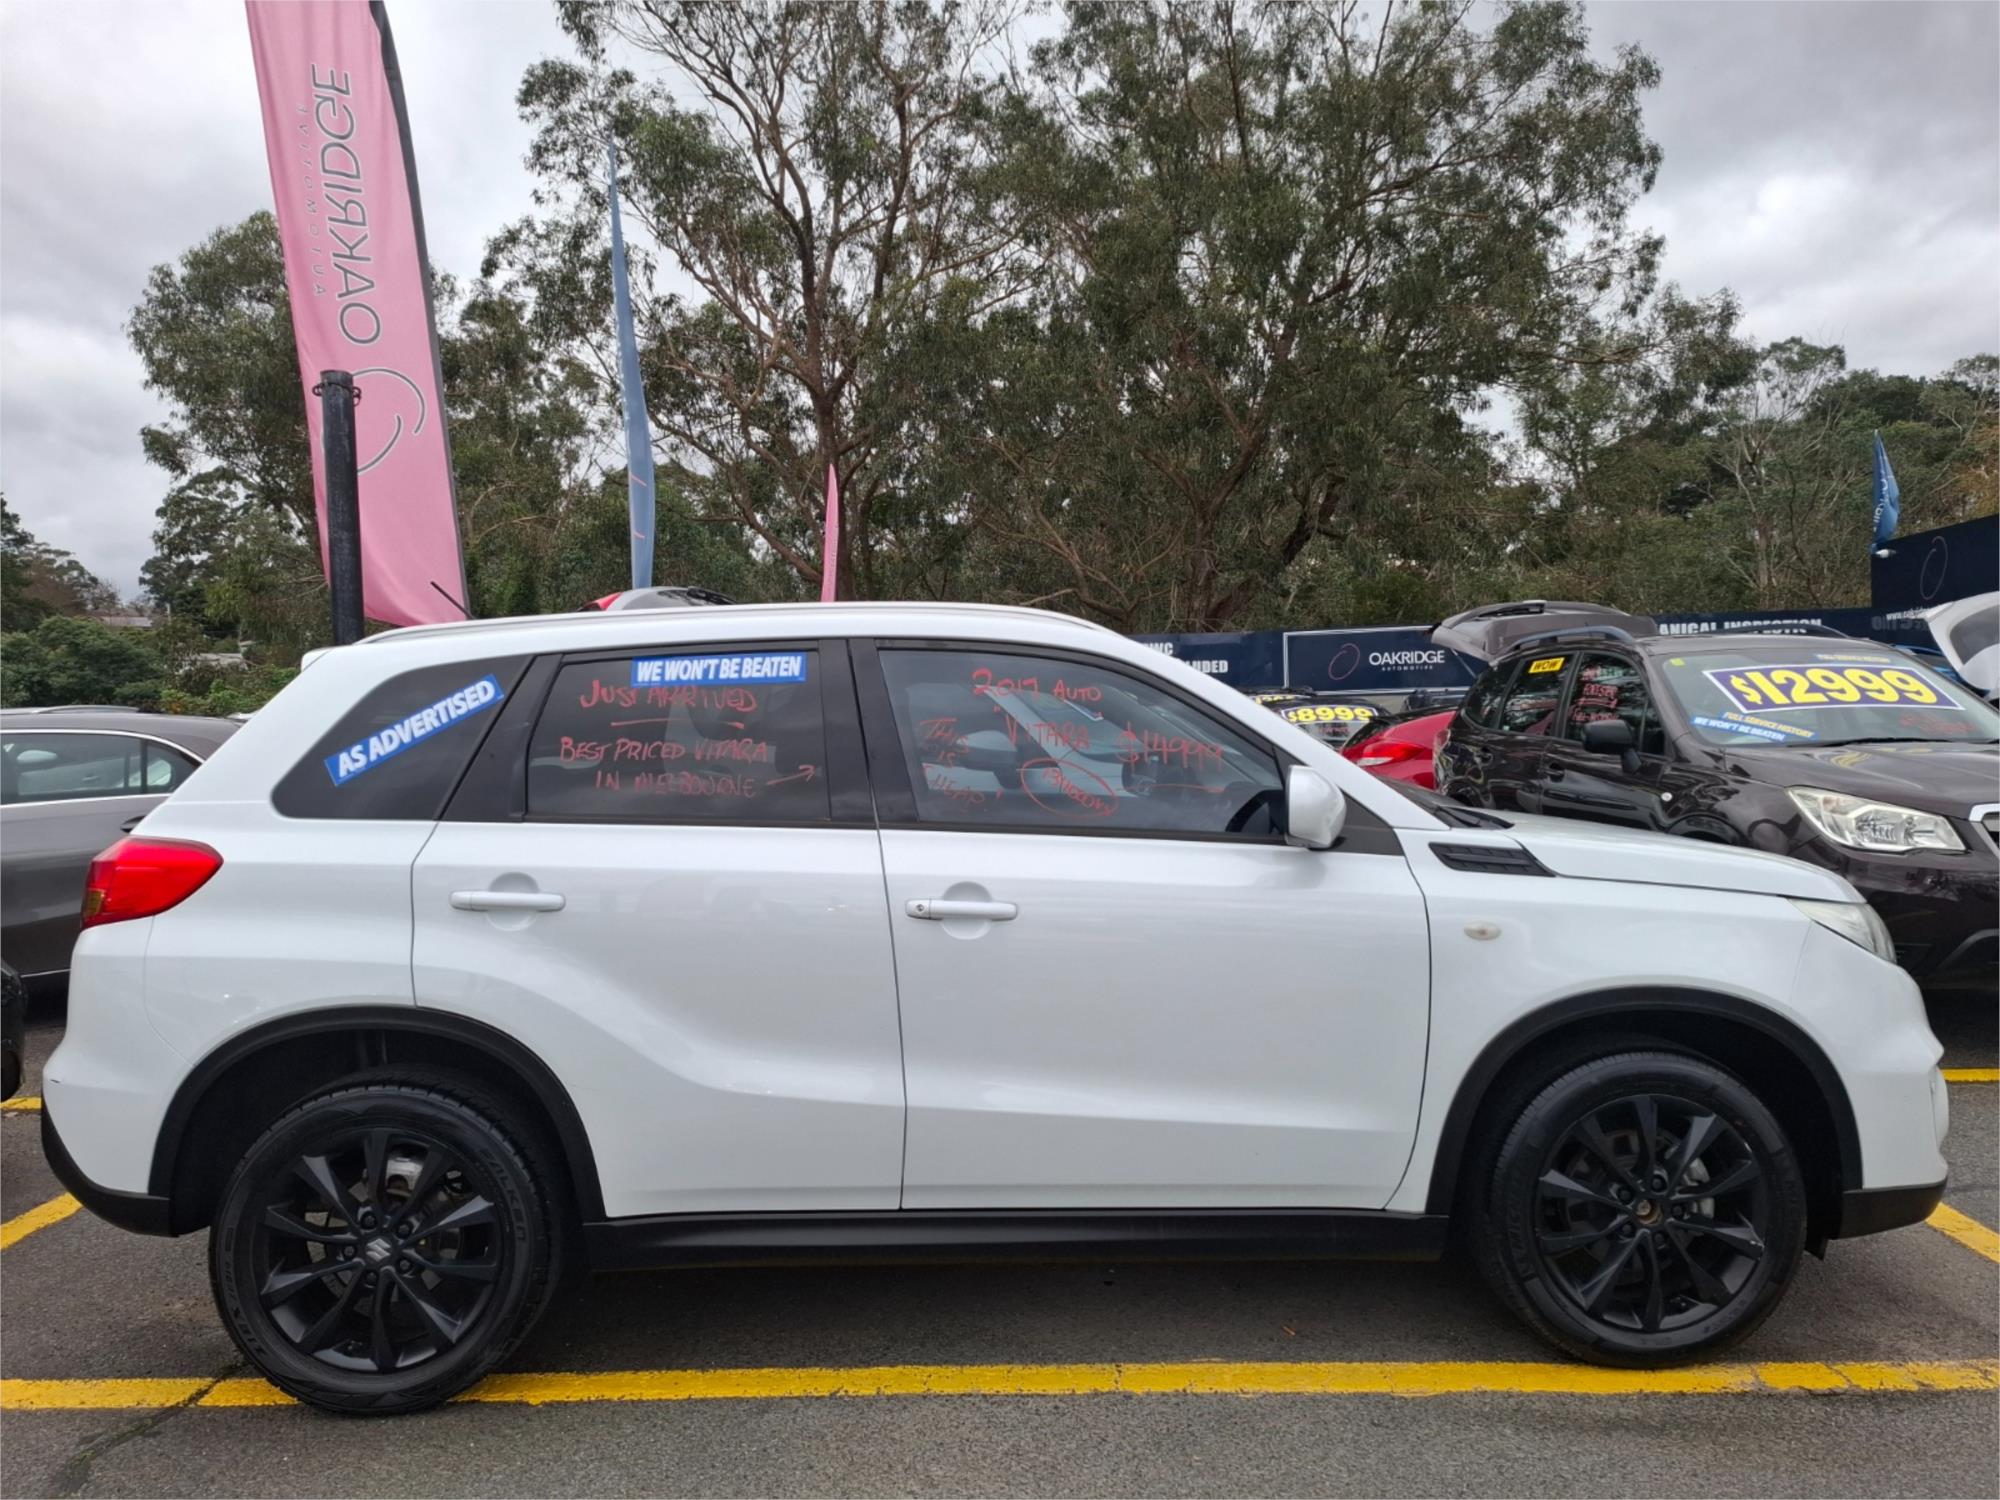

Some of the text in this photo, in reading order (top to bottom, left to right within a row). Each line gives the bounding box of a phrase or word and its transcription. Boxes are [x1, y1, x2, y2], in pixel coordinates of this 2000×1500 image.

[637, 655, 801, 682] WE WON'T BE BEATEN
[1369, 650, 1445, 666] OAKRIDGE
[580, 680, 637, 708] JUST
[972, 668, 1040, 700] 2017
[1730, 667, 1937, 704] $12999
[1288, 706, 1373, 723] $8999
[339, 680, 495, 778] AS ADVERTISED
[560, 736, 612, 763] BEST
[614, 737, 685, 761] PRICED
[595, 770, 621, 792] IN
